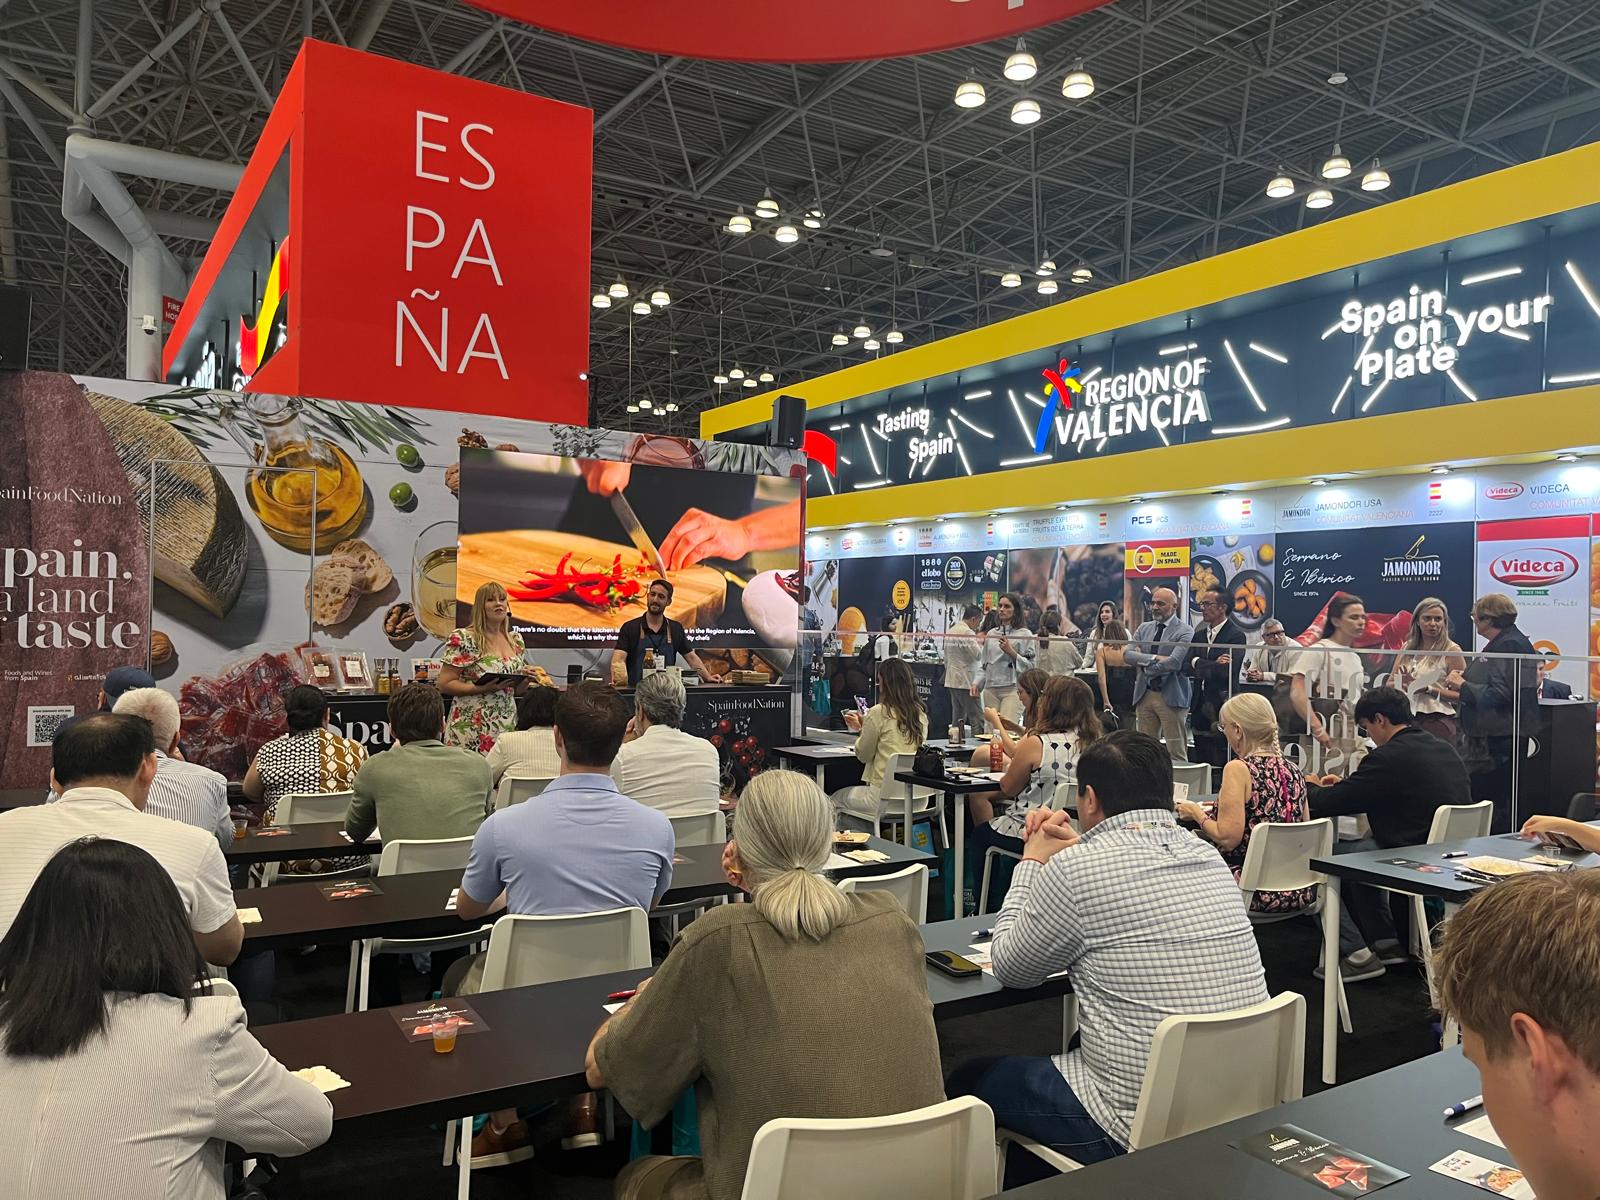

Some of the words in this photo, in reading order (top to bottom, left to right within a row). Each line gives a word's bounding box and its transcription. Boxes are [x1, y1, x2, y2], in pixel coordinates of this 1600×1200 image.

[415, 109, 497, 191] ES
[405, 205, 504, 287] PA
[165, 311, 178, 321] HOS
[167, 302, 181, 312] FIRE
[1341, 284, 1446, 336] Spain
[394, 287, 510, 382] ÑA
[1394, 317, 1443, 350] on
[1454, 295, 1553, 346] your
[1361, 345, 1456, 387] Plate
[1085, 364, 1170, 407] REGION
[1173, 357, 1207, 389] OF
[877, 406, 930, 435] Tasting
[1055, 389, 1208, 445] VALENCIA
[908, 431, 954, 463] Spain
[0, 486, 122, 505] ainFoodNation
[1530, 483, 1570, 495] VIDECA
[1314, 500, 1362, 512] JAMONDOR
[1363, 498, 1382, 508] USA
[1131, 516, 1153, 525] PCS
[1282, 547, 1342, 566] Serrano
[1381, 560, 1441, 577] JAMONDOR
[1500, 558, 1565, 573] Videca
[28, 578, 116, 613] land
[16, 612, 141, 649] taste
[707, 698, 785, 713] SpainFoodNation
